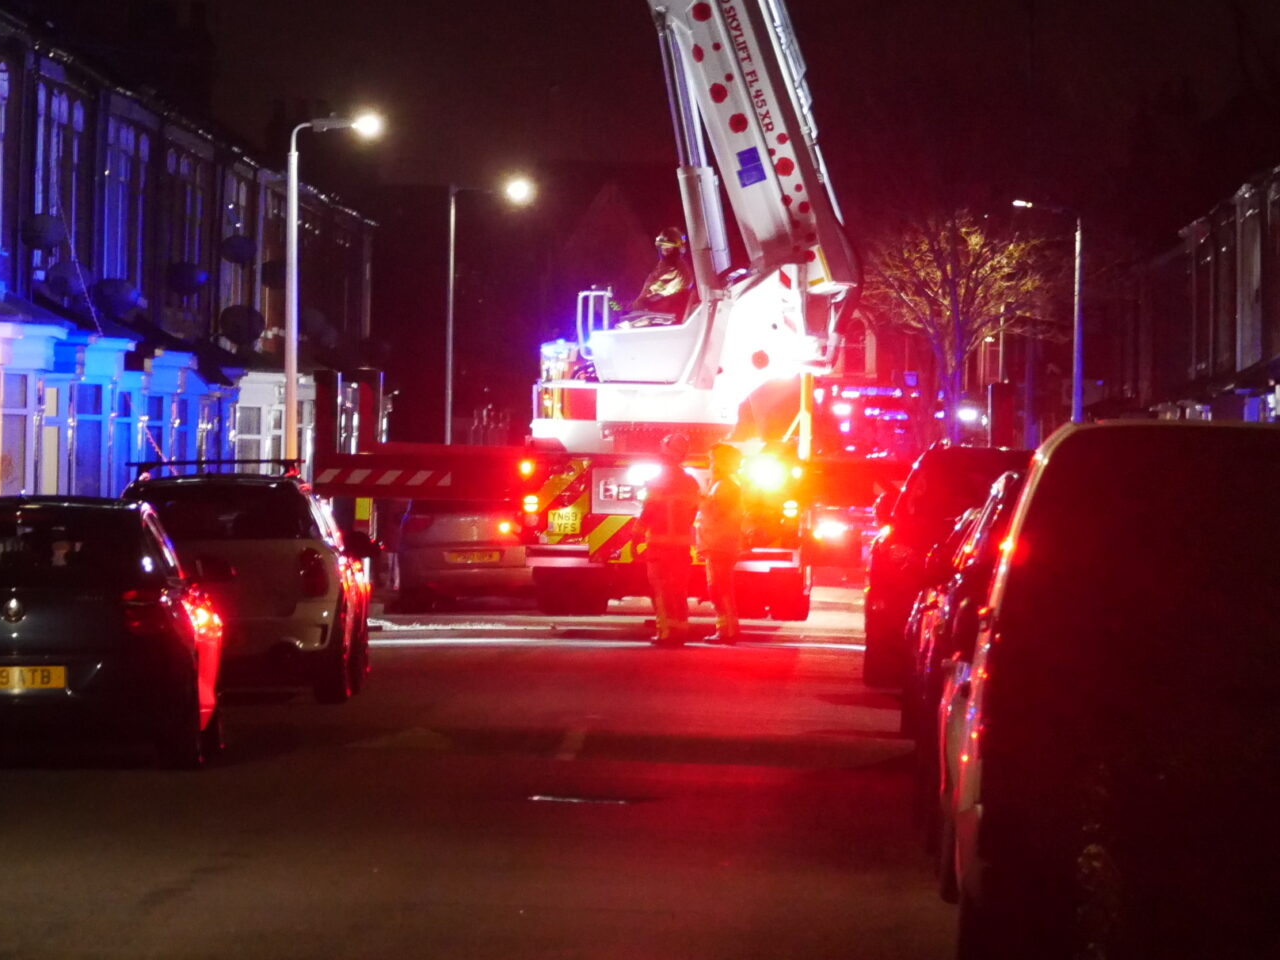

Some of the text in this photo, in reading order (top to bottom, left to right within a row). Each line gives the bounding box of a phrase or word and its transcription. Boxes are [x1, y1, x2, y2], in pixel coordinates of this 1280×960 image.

[721, 4, 753, 64] SKYLIFT
[744, 69, 759, 87] FL
[751, 88, 767, 109] 45
[757, 109, 775, 133] XR
[551, 511, 577, 521] YN69
[557, 523, 577, 532] YFS
